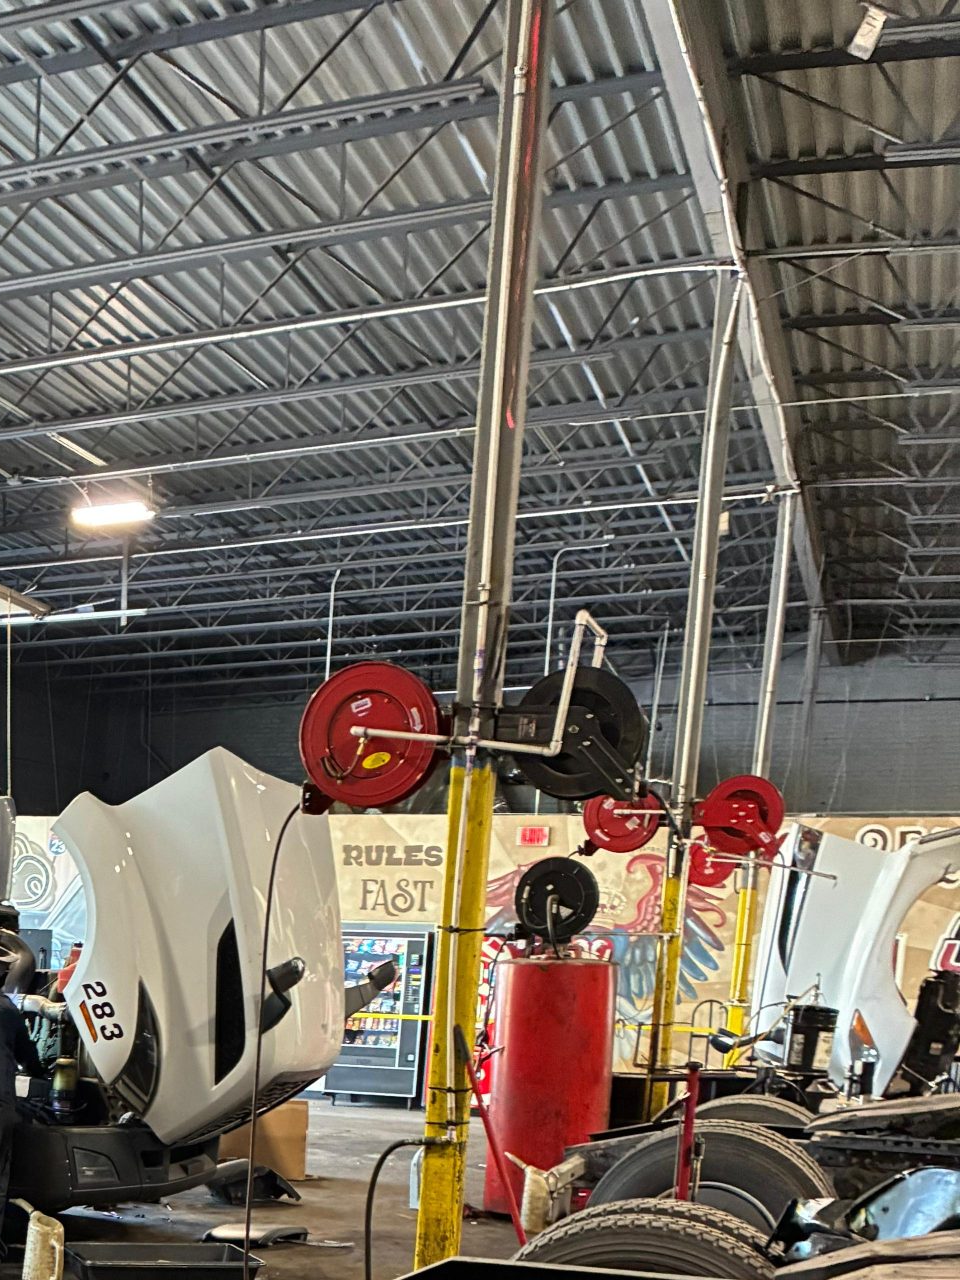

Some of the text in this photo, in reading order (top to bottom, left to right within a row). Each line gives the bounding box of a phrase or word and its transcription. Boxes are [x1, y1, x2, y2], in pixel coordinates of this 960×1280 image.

[342, 845, 443, 867] RULES
[359, 879, 434, 917] FAST
[82, 981, 124, 1041] 283
